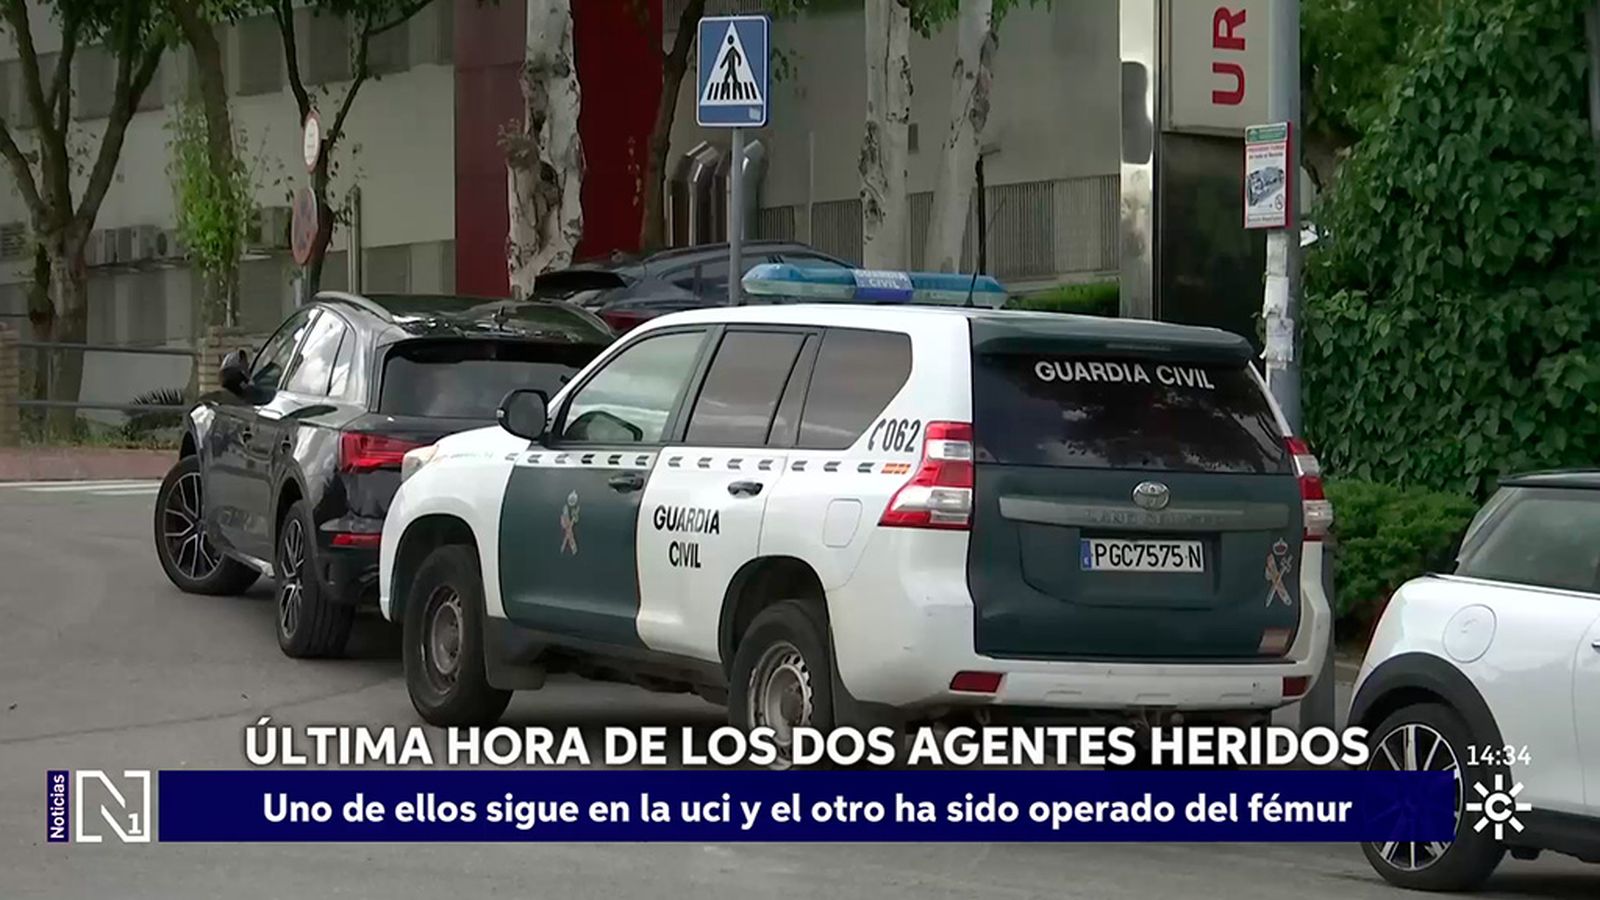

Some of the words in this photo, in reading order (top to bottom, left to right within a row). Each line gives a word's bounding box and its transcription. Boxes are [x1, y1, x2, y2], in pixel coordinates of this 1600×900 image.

[868, 279, 900, 289] CIVIL
[1034, 360, 1150, 384] GUARDIA
[1155, 366, 1215, 390] CIVIL
[880, 419, 921, 453] 062
[653, 504, 720, 535] GUARDIA
[669, 541, 702, 569] CIVIL
